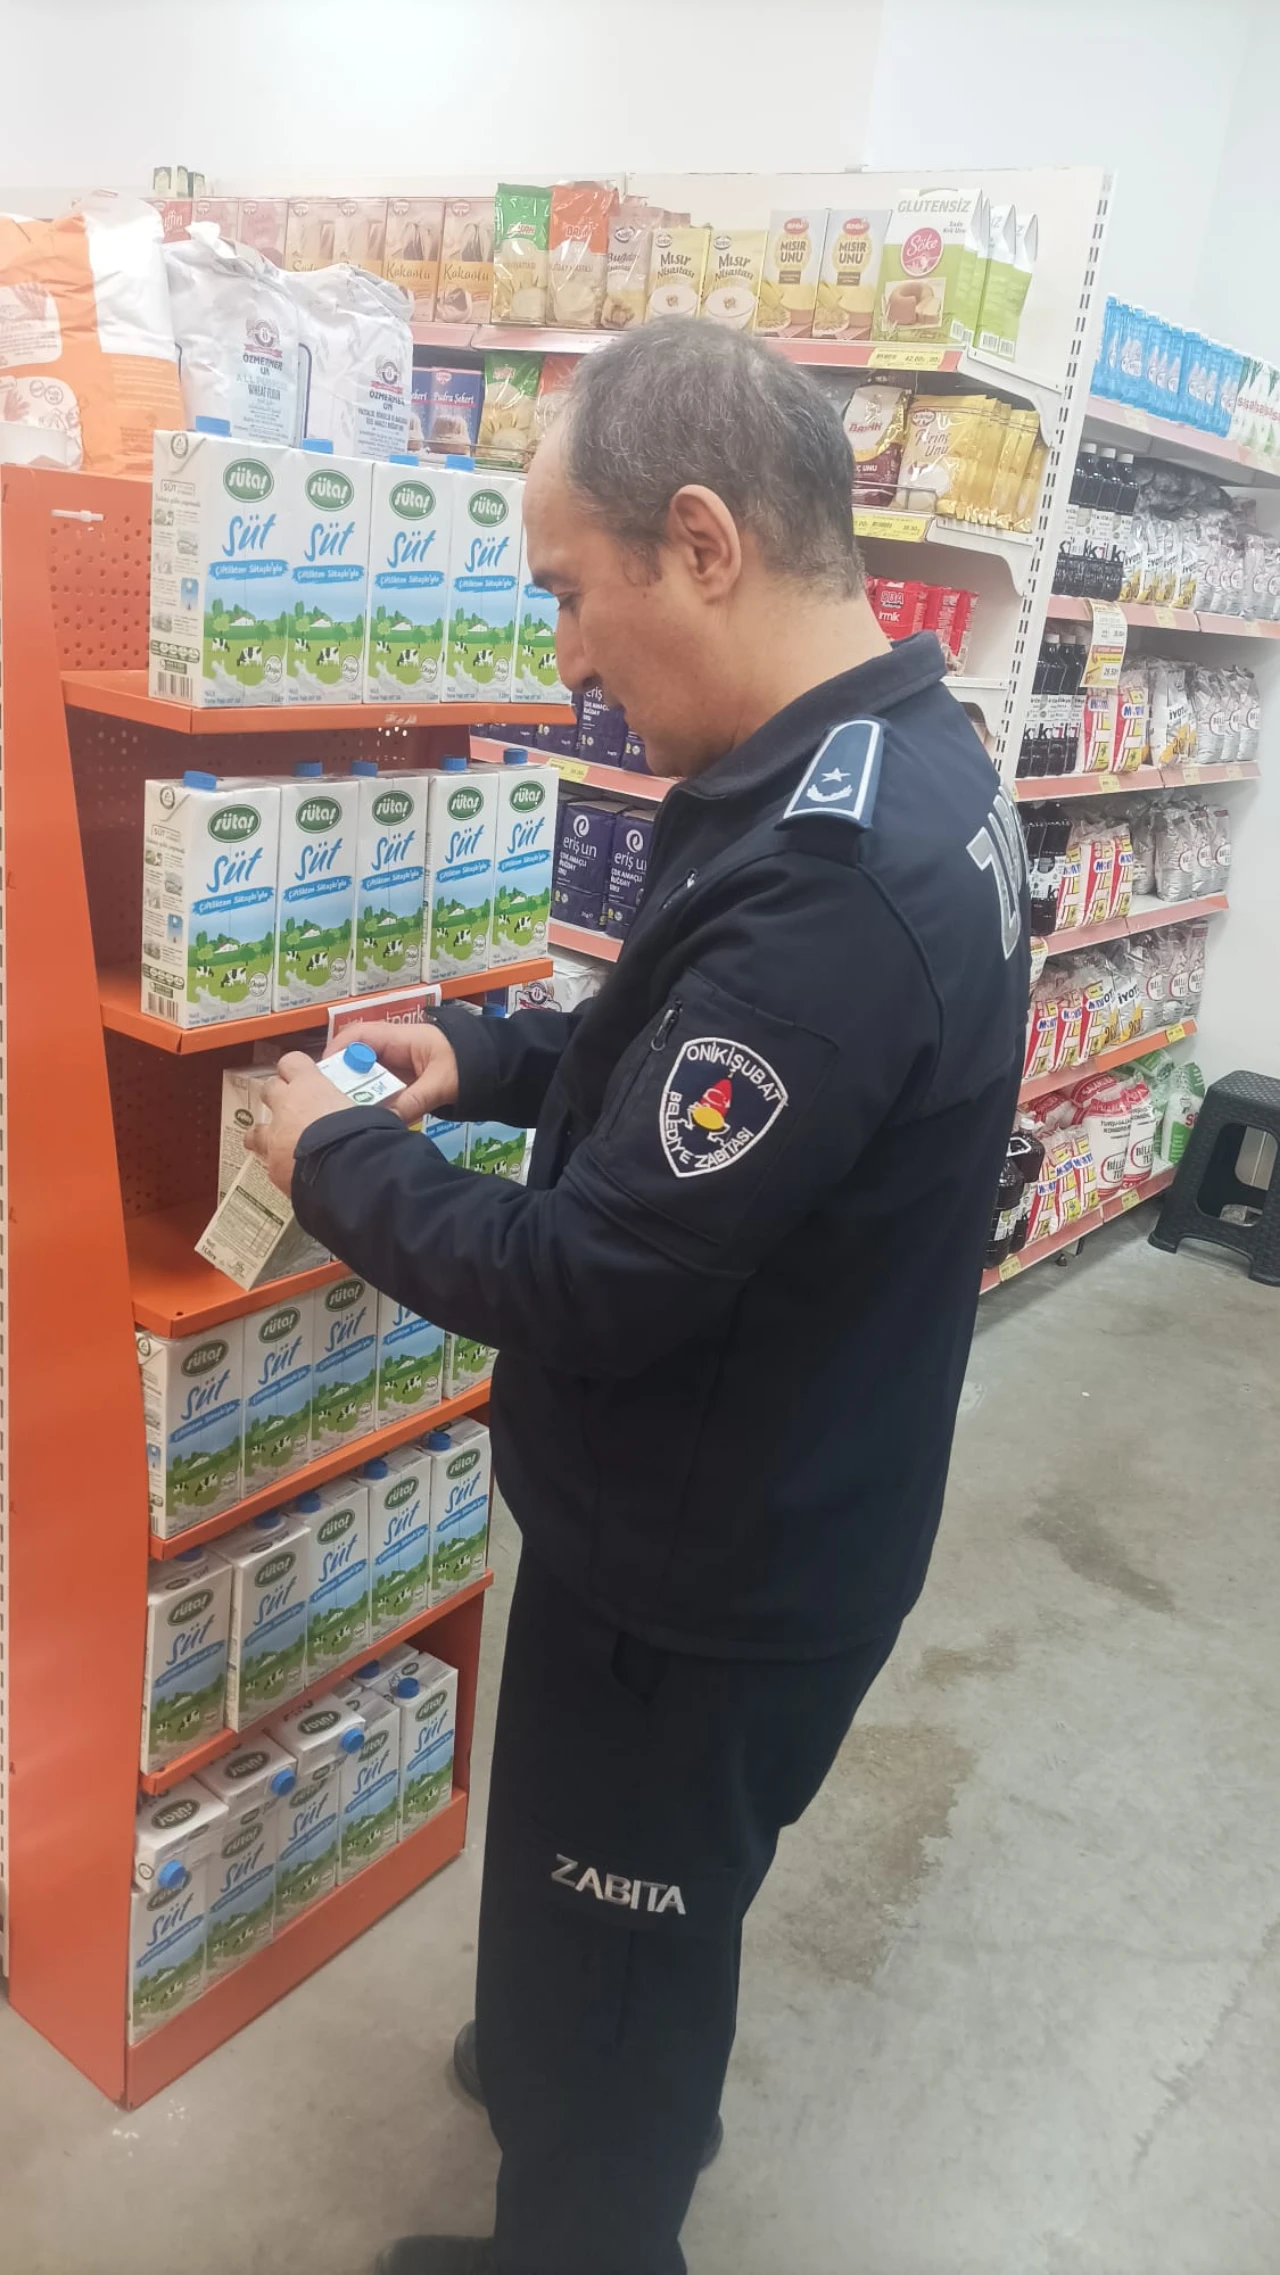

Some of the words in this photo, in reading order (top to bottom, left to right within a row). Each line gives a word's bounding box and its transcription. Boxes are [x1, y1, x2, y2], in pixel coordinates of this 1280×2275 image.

[897, 196, 972, 214] GLUTENSİZ
[780, 251, 804, 265] UNU
[838, 251, 864, 265] UNU
[906, 233, 940, 257] Söke
[442, 262, 491, 282] Kakaolu
[228, 465, 269, 496] sütaş
[310, 476, 349, 505] sütaş
[394, 486, 431, 514] sütaş
[472, 495, 504, 521] sütaş
[221, 512, 277, 558] Süt
[303, 520, 356, 563] Süt
[386, 528, 438, 569] Süt
[464, 535, 511, 573] Süt
[375, 797, 409, 819] sütaş
[450, 794, 480, 814] sütaş
[513, 786, 541, 806] sütaş
[214, 811, 256, 834] sütaş
[300, 803, 337, 826] sütaş
[370, 829, 416, 872] Süt
[444, 823, 486, 866] Süt
[506, 816, 546, 856] Süt
[562, 836, 581, 855] eriş
[580, 843, 598, 858] un
[205, 846, 265, 894] Süt
[293, 837, 345, 882] Süt
[614, 851, 634, 871] eriş
[329, 1286, 360, 1305] sütaş
[263, 1314, 295, 1338] sütaş
[324, 1306, 368, 1352] Süt
[185, 1346, 223, 1371] sütaş
[257, 1335, 304, 1386] Süt
[180, 1368, 232, 1422] Süt
[448, 1452, 478, 1477] sütaş
[387, 1480, 417, 1507] sütaş
[444, 1470, 482, 1514] Süt
[320, 1513, 352, 1540] sütaş
[383, 1499, 421, 1547] Süt
[258, 1558, 292, 1583] sütaş
[318, 1532, 359, 1583] Süt
[172, 1594, 208, 1621] sütaş
[252, 1574, 299, 1627] Süt
[165, 1613, 216, 1666] Süt
[414, 1708, 450, 1754] Süt
[352, 1748, 391, 1795] Süt
[288, 1792, 330, 1842] Süt
[220, 1841, 265, 1893] Süt
[550, 1852, 687, 1916] ZABITA
[146, 1891, 195, 1947] Süt
